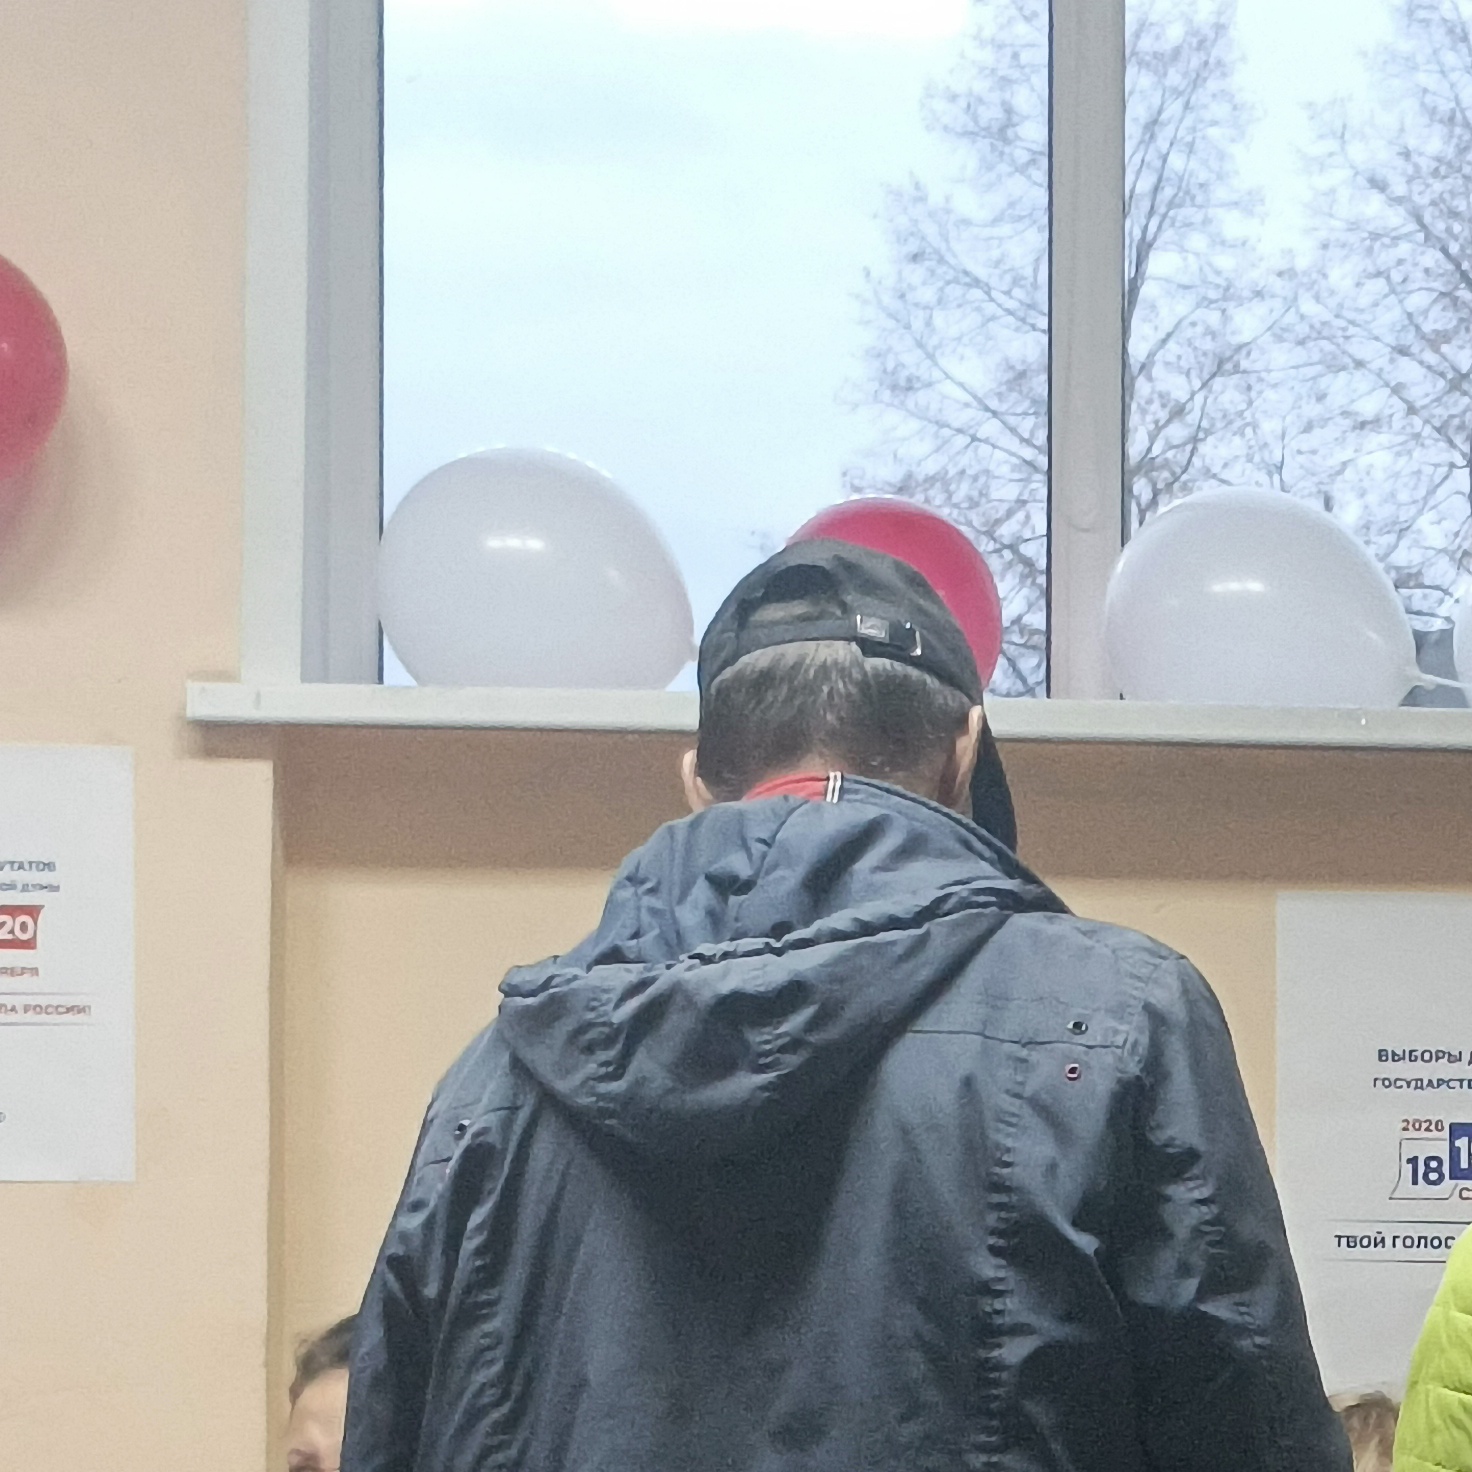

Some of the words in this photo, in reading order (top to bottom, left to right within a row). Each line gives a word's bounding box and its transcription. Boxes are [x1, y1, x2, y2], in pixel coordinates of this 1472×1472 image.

[0, 914, 35, 941] 20
[1377, 1048, 1463, 1064] ВЫБОРЫ
[1406, 1155, 1446, 1186] 18
[1333, 1230, 1386, 1249] ТВОЙ
[1392, 1234, 1456, 1250] ГОЛОС
